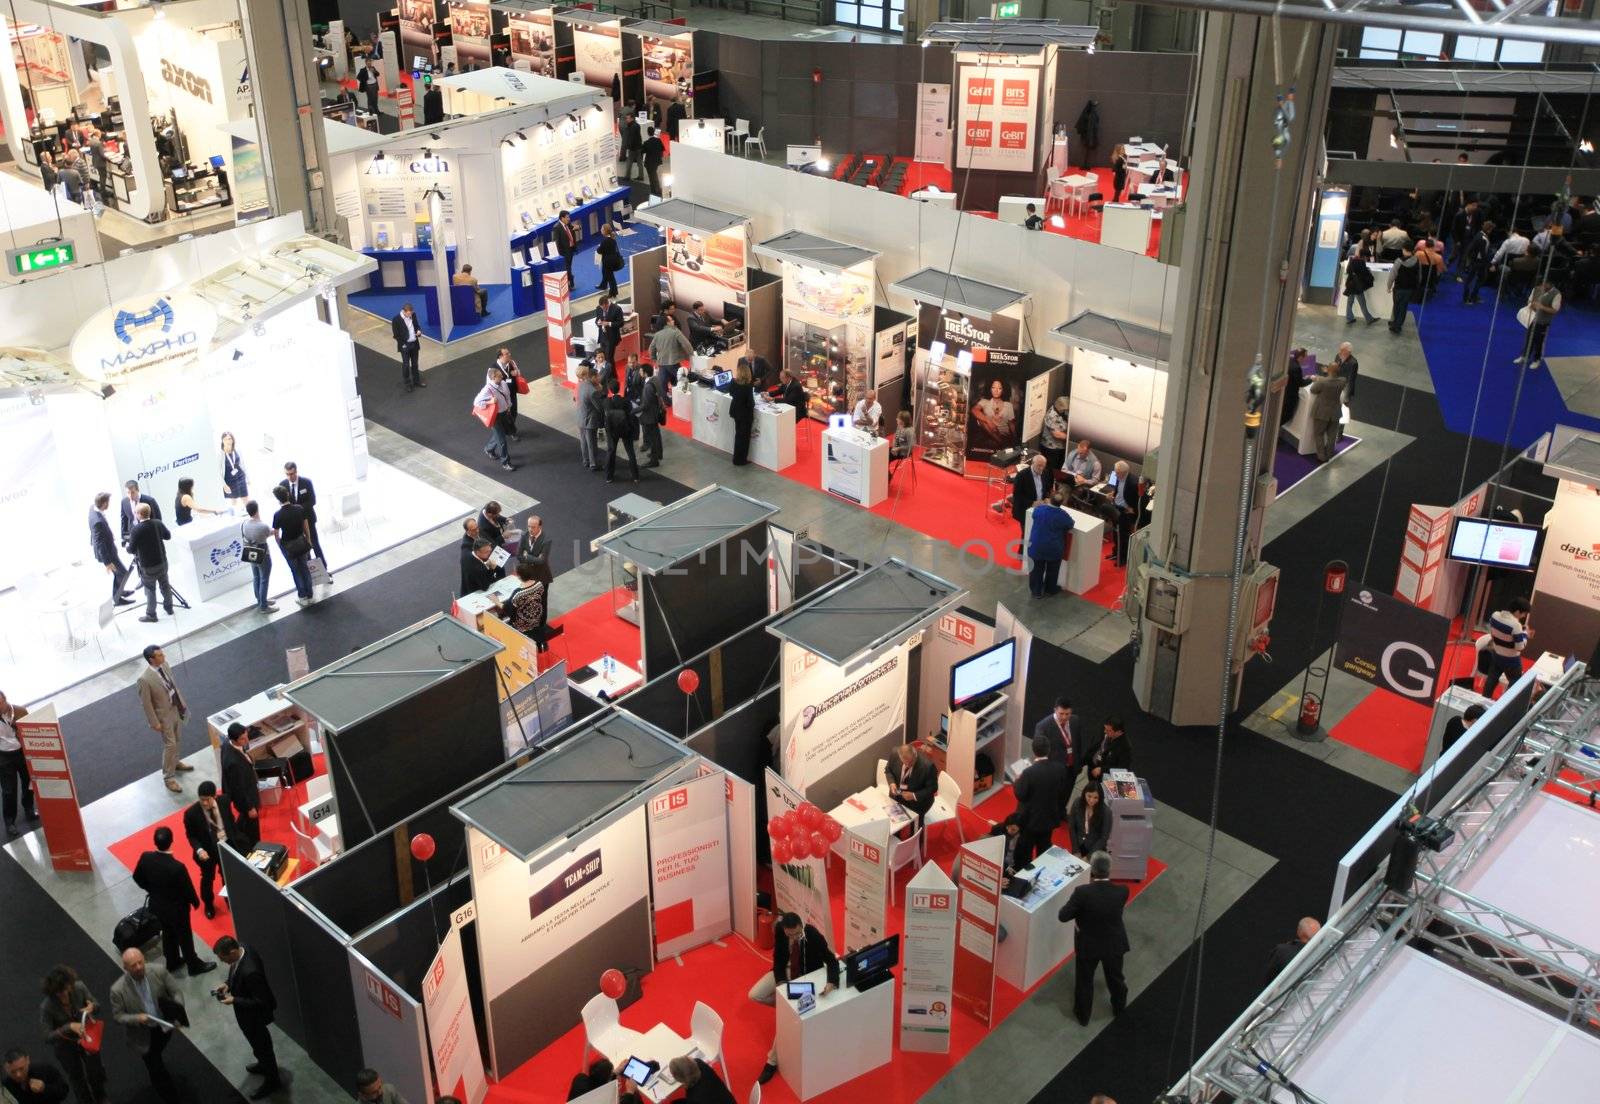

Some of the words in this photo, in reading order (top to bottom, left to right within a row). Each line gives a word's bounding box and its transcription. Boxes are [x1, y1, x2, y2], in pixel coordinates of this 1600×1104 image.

[1005, 88, 1025, 98] BITS
[1000, 130, 1025, 140] CeBIT
[945, 331, 968, 346] Enjoy
[100, 331, 197, 371] MAXPHO
[137, 463, 170, 481] PayPal
[941, 616, 954, 632] IT
[959, 623, 972, 640] IS
[1354, 656, 1377, 672] Corsia
[1380, 641, 1435, 698] G
[29, 740, 55, 748] Kodak
[656, 799, 666, 812] IT
[672, 792, 686, 807] IS
[313, 804, 331, 820] G14
[657, 840, 720, 867] PROFESSIONISTI
[852, 841, 863, 853] IT
[867, 847, 877, 861] IS
[657, 865, 673, 875] PER
[684, 855, 699, 866] TUO
[657, 865, 696, 883] BUSINESS
[915, 896, 929, 906] IT
[934, 897, 947, 908] IS
[455, 908, 473, 925] G16
